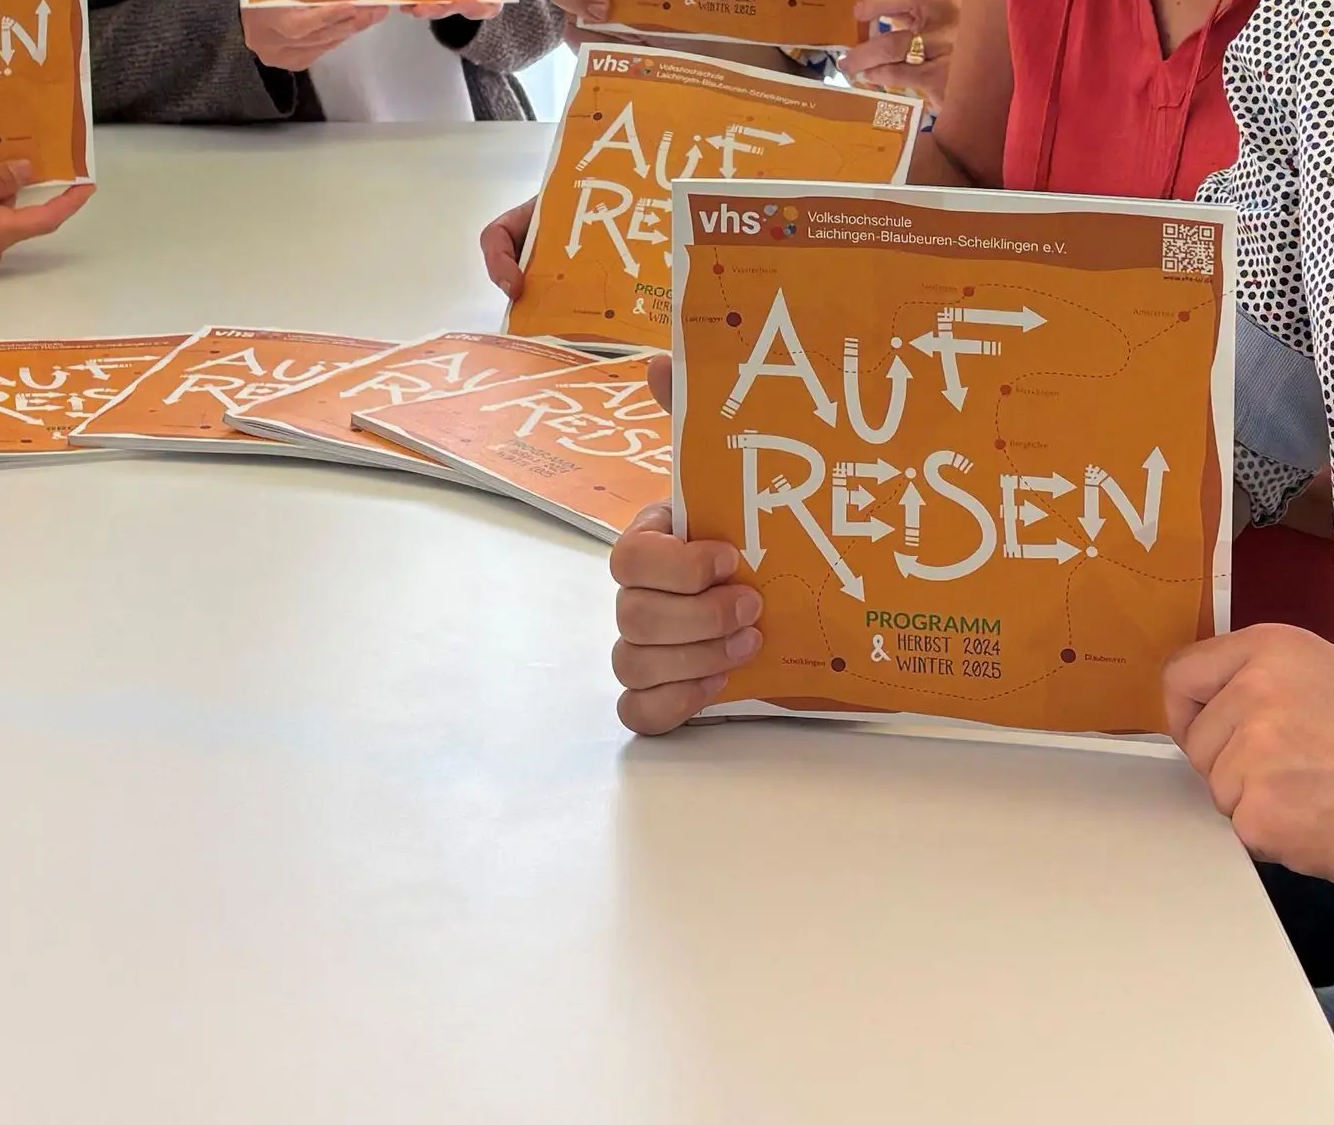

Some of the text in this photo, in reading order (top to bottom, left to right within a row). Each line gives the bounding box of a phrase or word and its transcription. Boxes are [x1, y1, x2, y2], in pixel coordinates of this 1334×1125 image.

[592, 54, 630, 73] vhs
[699, 204, 761, 234] vhs
[807, 211, 912, 228] Volkshochschule
[807, 227, 1067, 254] Laichingen-Blaubeuren-Schelklingen e.V.
[633, 297, 647, 314] &
[720, 287, 1048, 444] AUF
[555, 381, 670, 420] AU
[866, 610, 1001, 636] PROGRAMM
[870, 634, 891, 663] &
[897, 633, 1001, 656] HERBST 2024
[896, 655, 1002, 680] WINTER 2025
